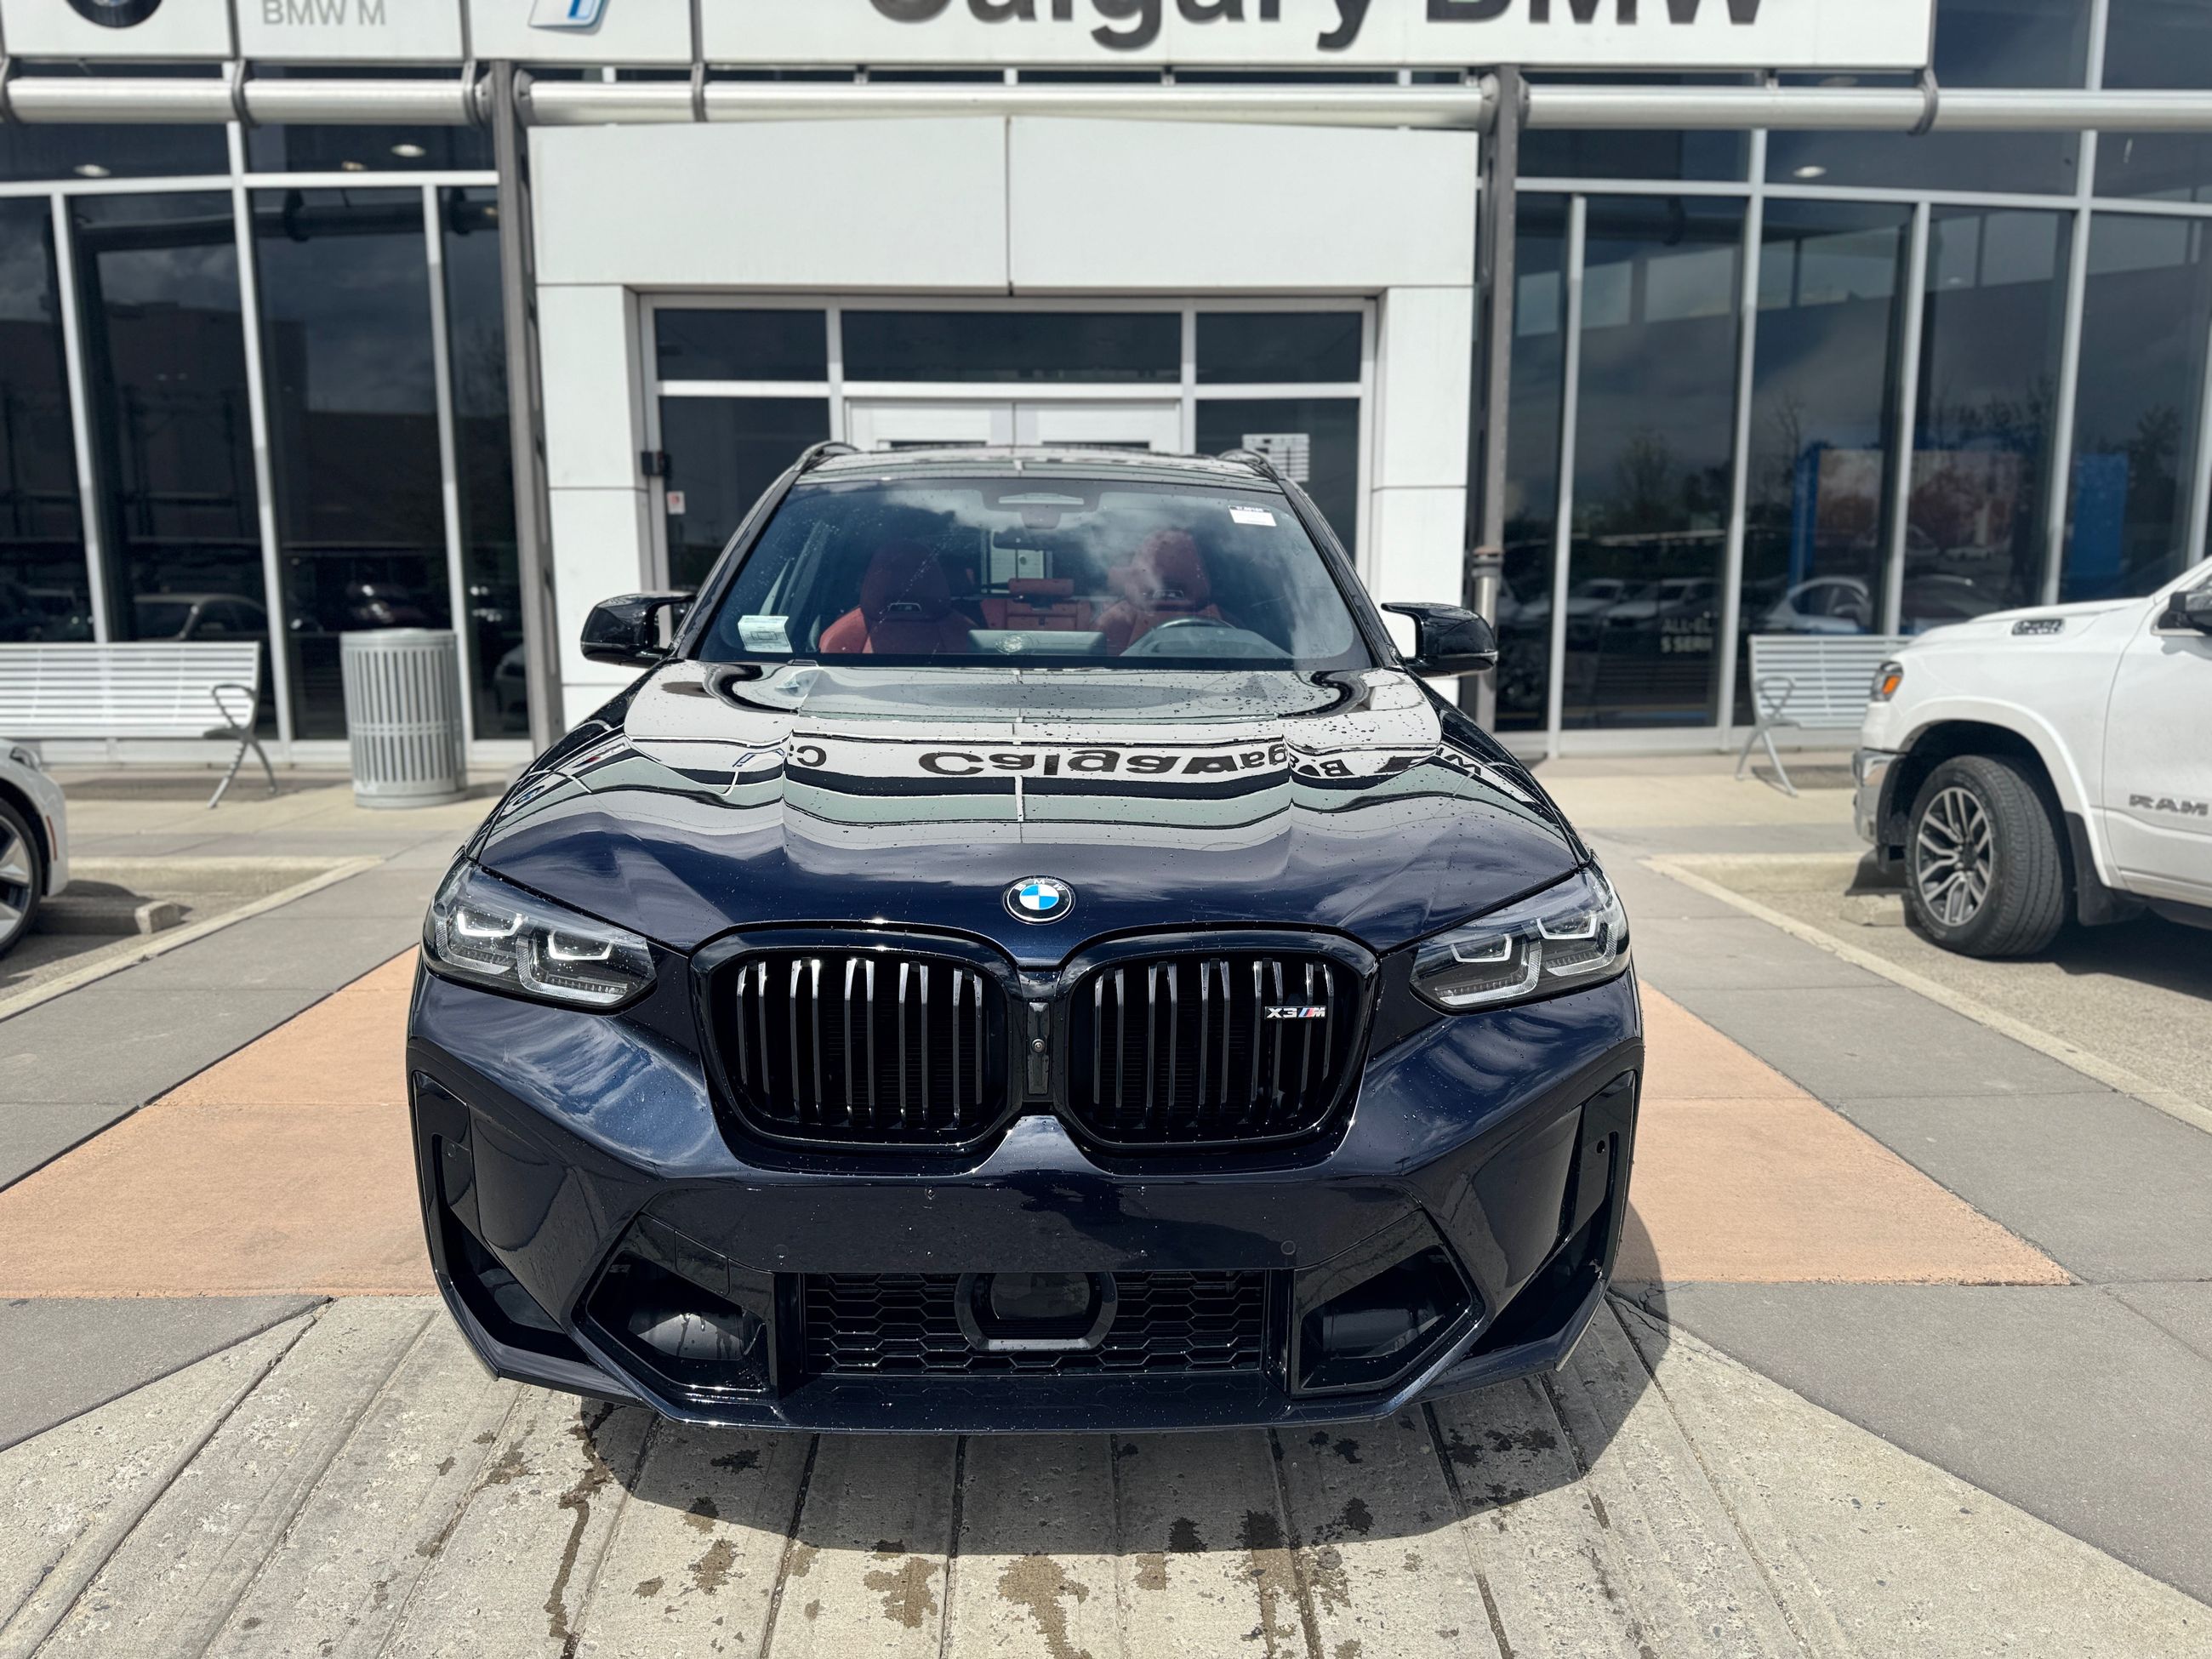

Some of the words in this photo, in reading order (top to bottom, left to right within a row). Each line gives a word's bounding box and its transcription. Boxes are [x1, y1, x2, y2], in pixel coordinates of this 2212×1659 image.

[263, 0, 346, 26] BMW
[358, 0, 386, 26] M
[2129, 793, 2209, 817] RAM
